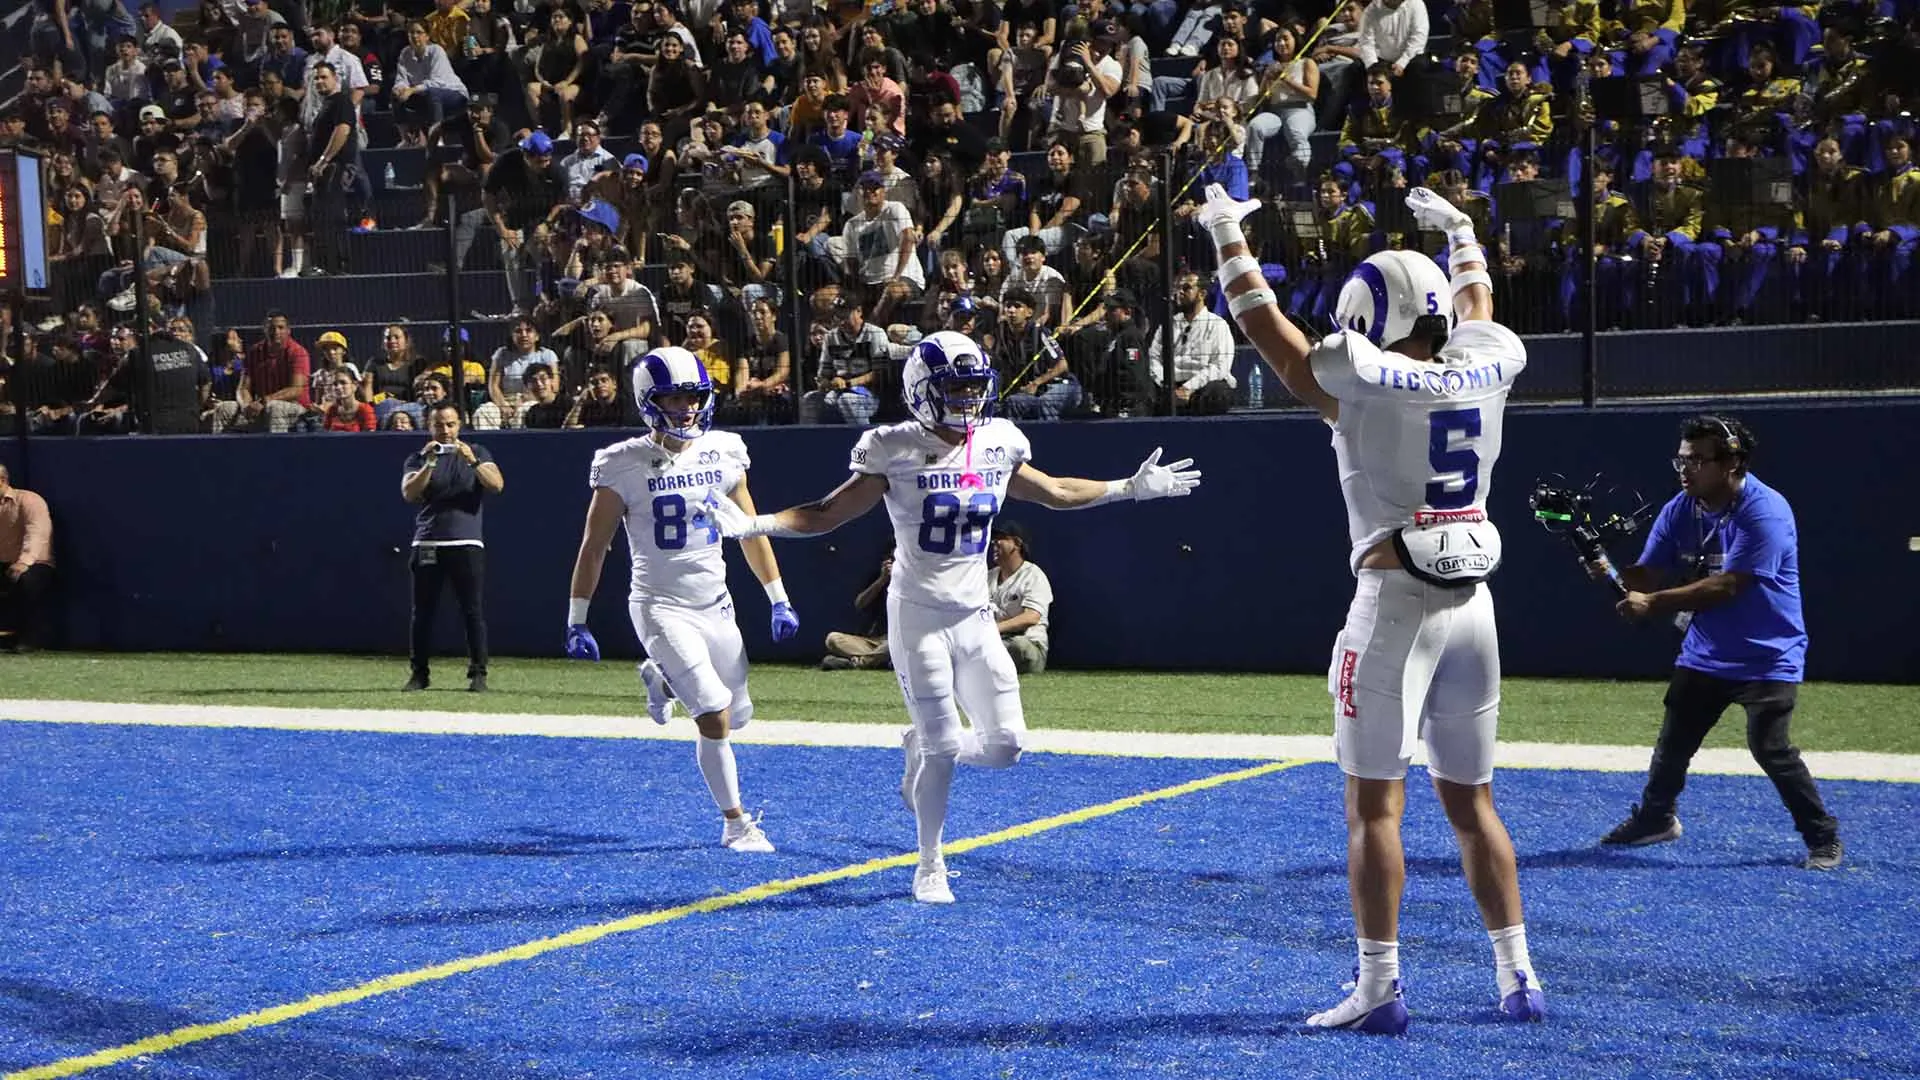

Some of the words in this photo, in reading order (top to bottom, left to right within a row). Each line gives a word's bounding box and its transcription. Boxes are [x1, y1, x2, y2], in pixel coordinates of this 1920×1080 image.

[1426, 292, 1439, 315] 5
[1378, 366, 1421, 391] TEC
[1467, 362, 1502, 390] MTY
[1425, 407, 1482, 510] 5
[648, 469, 723, 492] BORREGOS
[917, 470, 1002, 490] BORROS
[918, 492, 998, 555] 88
